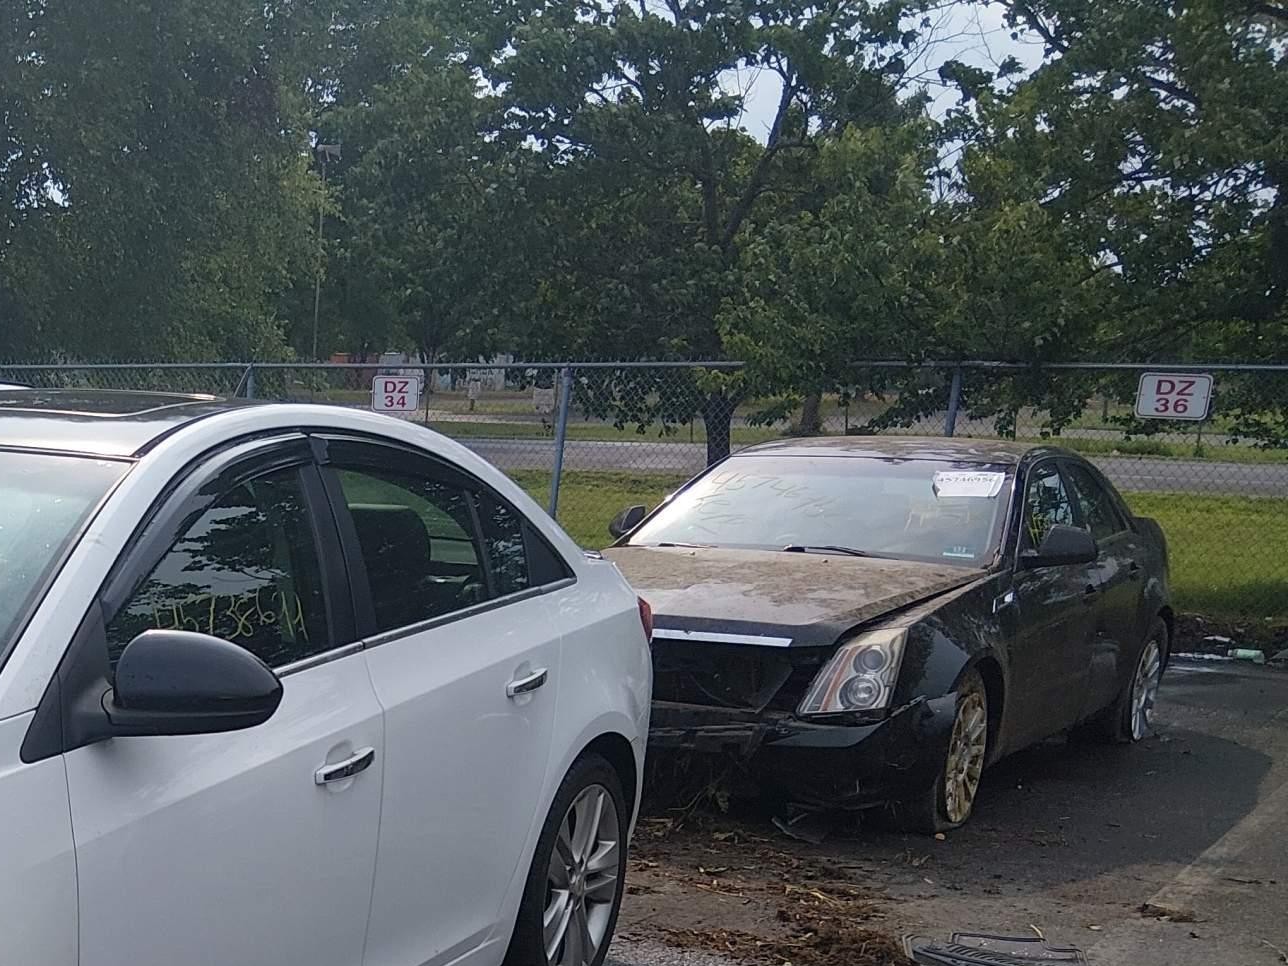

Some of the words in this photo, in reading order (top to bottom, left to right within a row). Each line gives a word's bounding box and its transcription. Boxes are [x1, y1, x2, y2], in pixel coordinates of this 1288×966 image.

[384, 381, 409, 394] DZ
[1155, 379, 1196, 396] DZ
[384, 395, 407, 408] 34
[1154, 398, 1189, 414] 36
